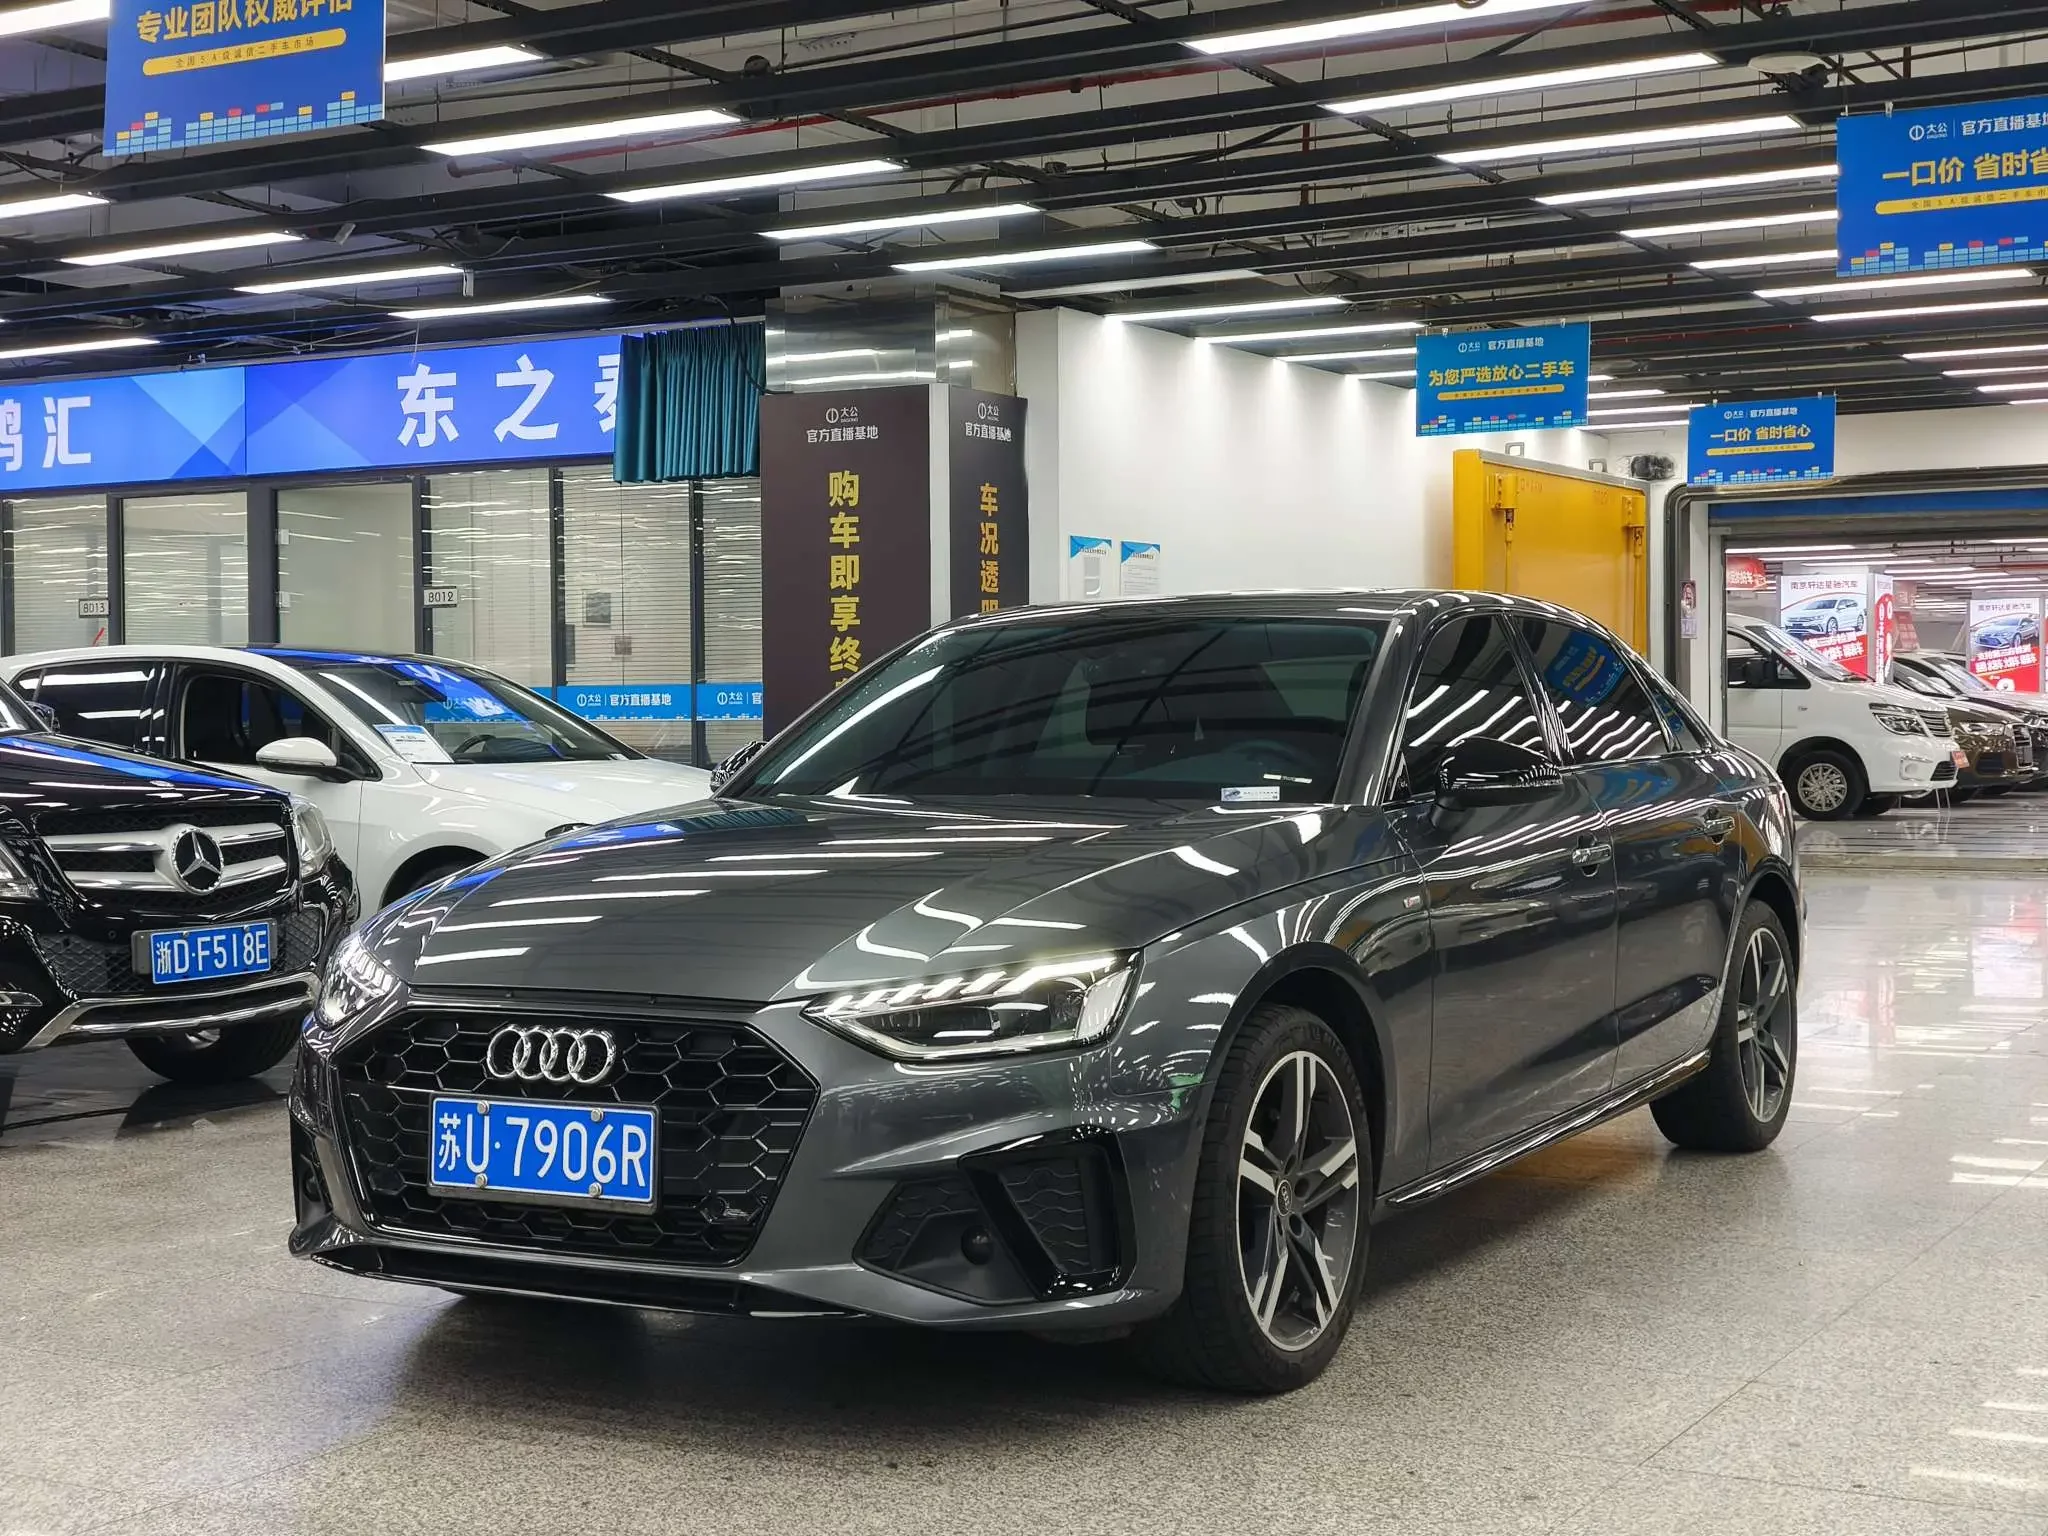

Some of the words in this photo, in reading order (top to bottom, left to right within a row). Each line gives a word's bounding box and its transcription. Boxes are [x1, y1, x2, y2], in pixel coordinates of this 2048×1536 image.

[1882, 156, 1965, 187] 一口价
[1428, 360, 1575, 387] 为您严选放心二手车
[840, 407, 858, 417] 大公
[806, 425, 879, 443] 官方直播基地
[965, 422, 1012, 442] 官方直播基地
[1710, 427, 1752, 442] 一口价
[1755, 424, 1811, 441] 省时省心
[828, 469, 861, 688] 购车即享终
[609, 693, 672, 707] 官方直播基地
[156, 930, 268, 975] 浙D·F518E
[438, 1111, 647, 1188] 苏U·7906R
